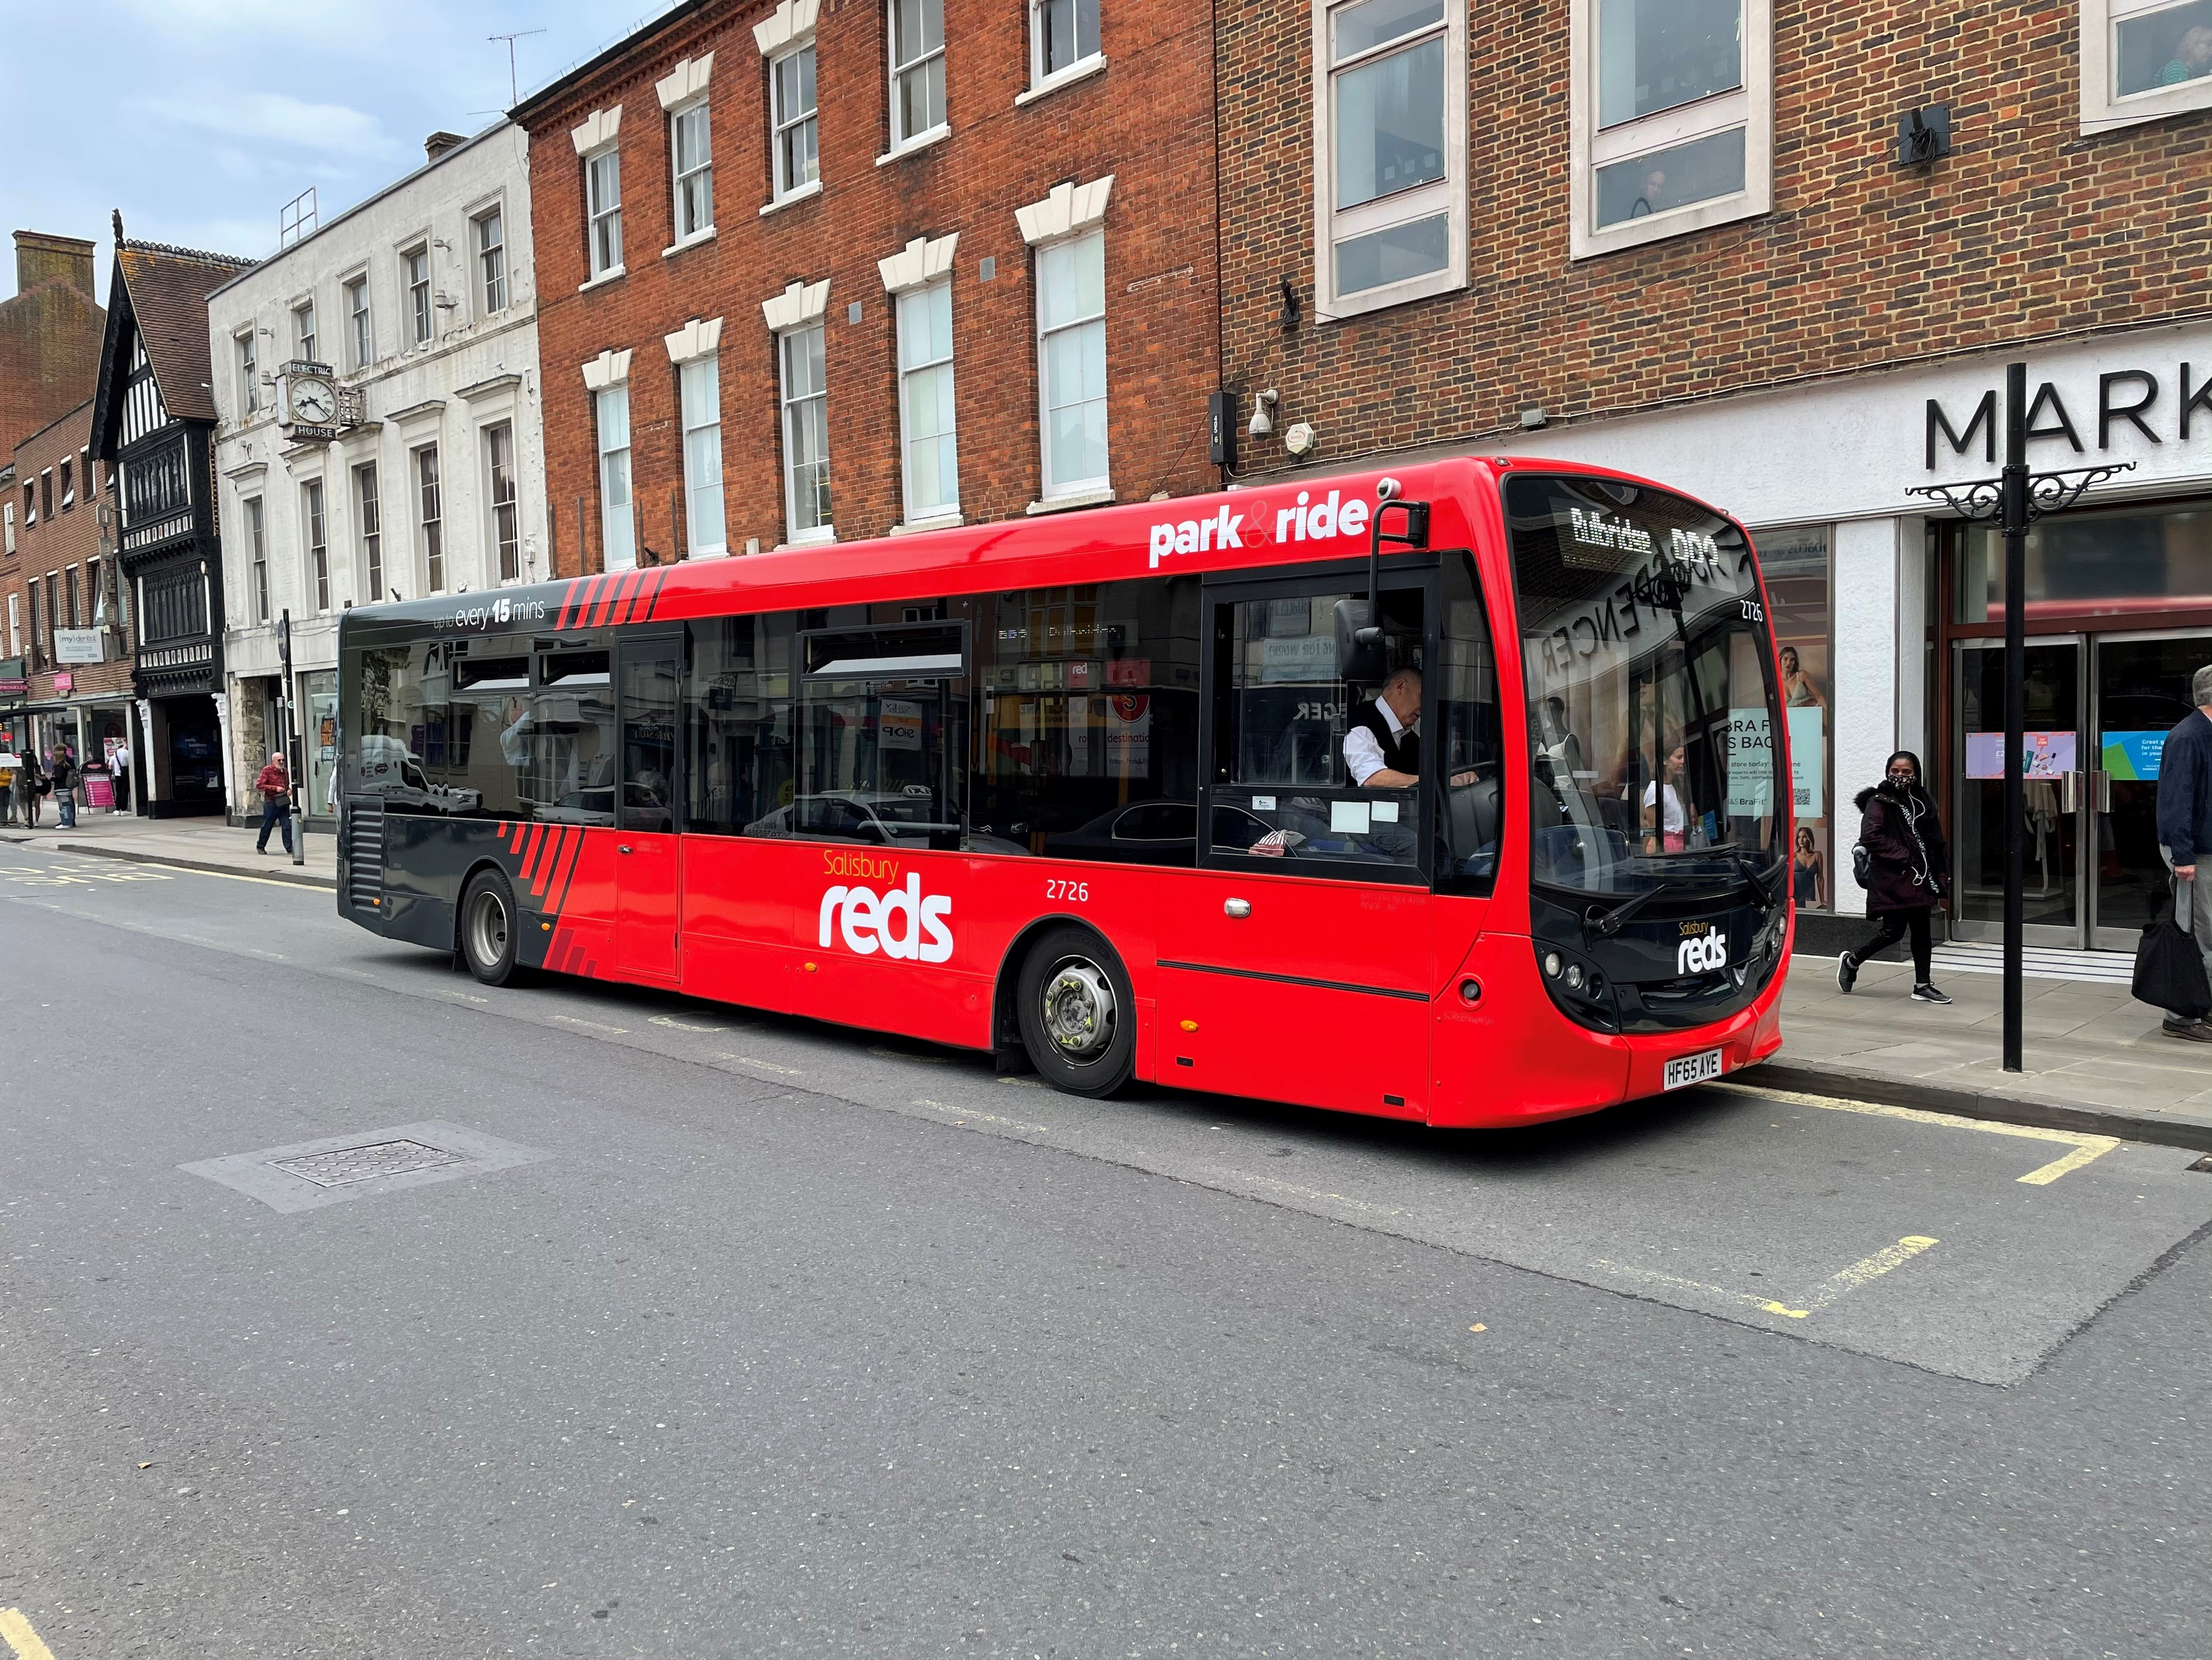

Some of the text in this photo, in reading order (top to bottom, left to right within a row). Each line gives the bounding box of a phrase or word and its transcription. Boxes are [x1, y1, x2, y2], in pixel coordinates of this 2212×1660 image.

[292, 363, 331, 375] ELECTRIC
[299, 426, 333, 438] HOUSE
[1926, 362, 2212, 470] MARK
[1149, 504, 1244, 569] park
[1276, 489, 1369, 543] ride
[455, 606, 490, 630] every
[492, 598, 511, 623] 15
[513, 596, 545, 621] mins
[1740, 599, 1763, 622] 2726
[1072, 662, 1088, 675] red
[824, 850, 899, 885] Salisbury
[1047, 880, 1088, 901] 2726
[819, 872, 953, 963] reds
[1679, 920, 1709, 936] Salisbury
[1678, 926, 1727, 975] reds
[1668, 1053, 1718, 1085] HF65 AYE
